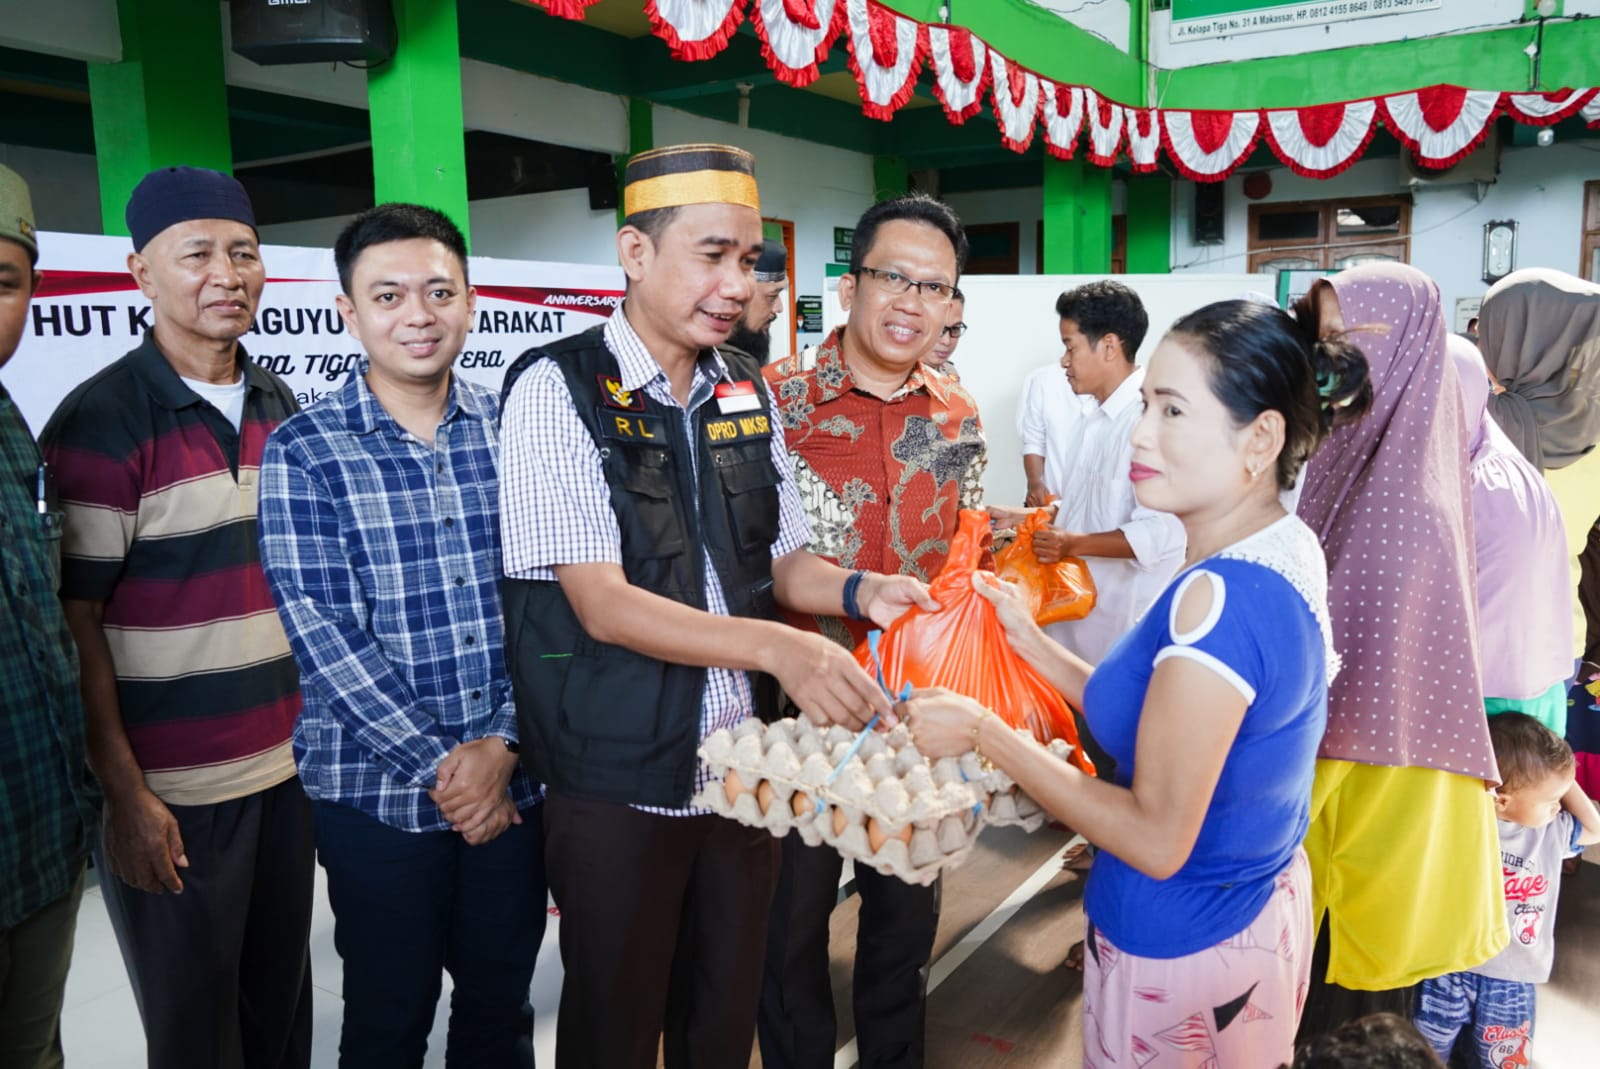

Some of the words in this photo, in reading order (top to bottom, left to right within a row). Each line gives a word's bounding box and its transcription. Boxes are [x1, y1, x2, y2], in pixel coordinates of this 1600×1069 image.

[1187, 24, 1211, 35] Kelapa
[1213, 22, 1227, 32] Tiga
[1229, 20, 1240, 28] No.
[1260, 14, 1295, 24] Makassar,
[32, 304, 117, 336] HUT
[467, 310, 565, 334] ARAKAT
[706, 420, 738, 441] DPRD
